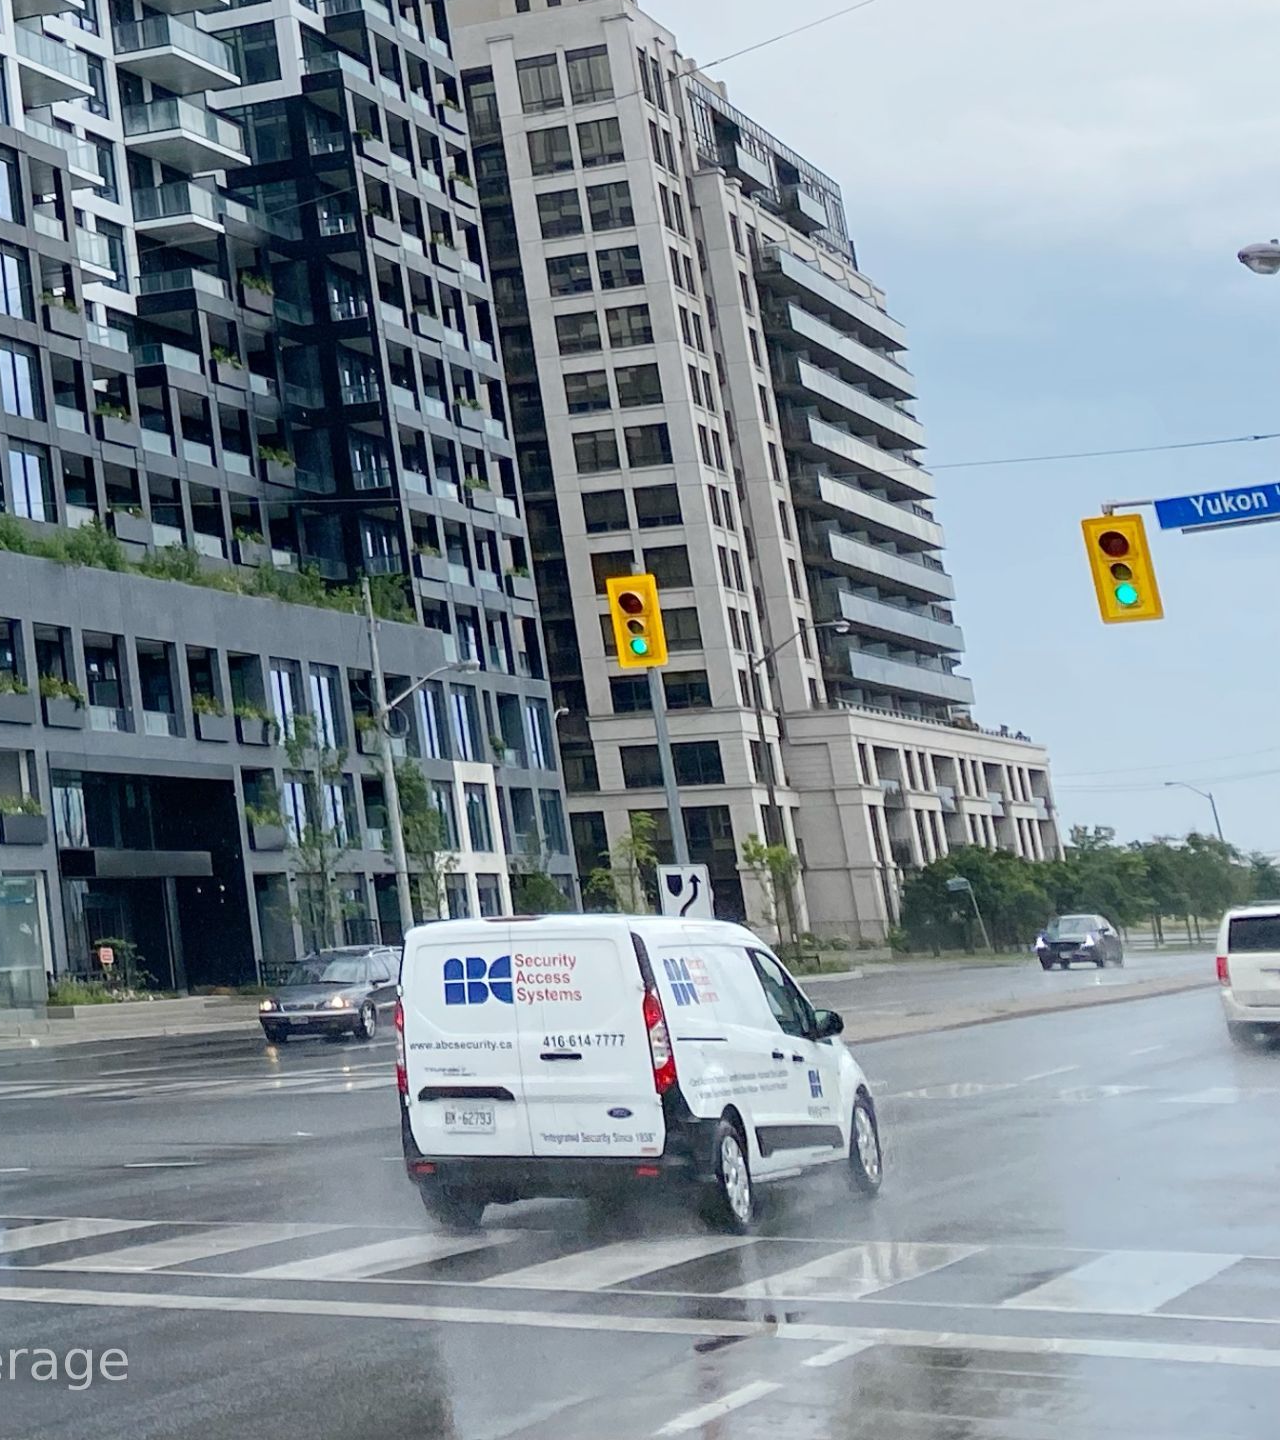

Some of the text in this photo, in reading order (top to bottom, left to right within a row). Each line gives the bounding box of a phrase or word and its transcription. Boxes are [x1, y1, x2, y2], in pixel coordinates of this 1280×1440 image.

[1189, 490, 1269, 517] Yukon
[514, 953, 577, 971] Security
[443, 954, 515, 1006] ABC
[515, 970, 571, 985] Access
[516, 987, 583, 1006] Systems
[409, 1040, 513, 1051] www.abcsecurity.ca
